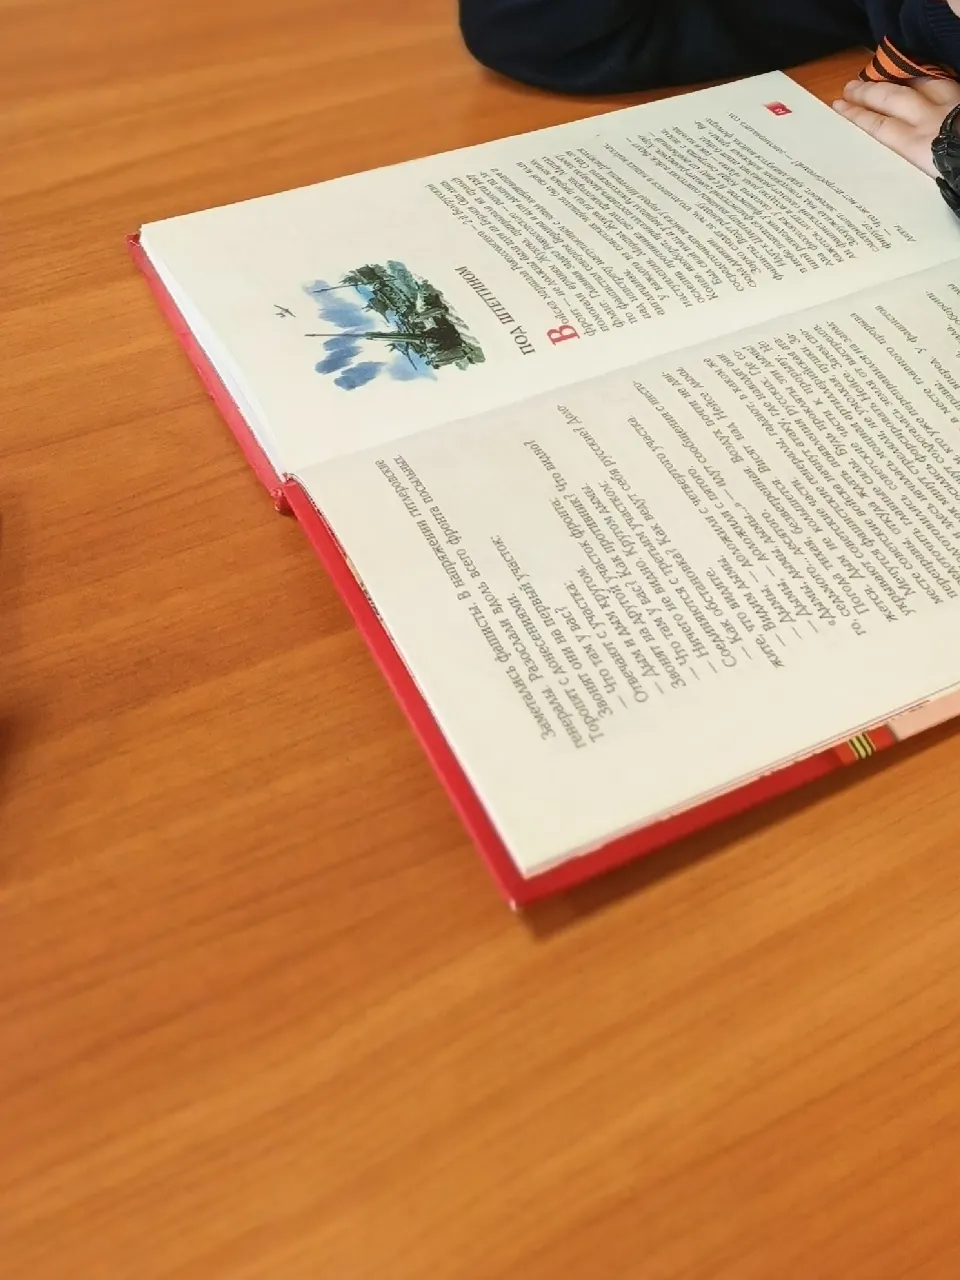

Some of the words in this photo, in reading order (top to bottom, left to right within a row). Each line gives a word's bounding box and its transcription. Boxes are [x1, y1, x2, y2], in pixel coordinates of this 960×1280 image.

[453, 265, 517, 326] ШТЕТТИНОМ
[508, 324, 537, 356] ПОД
[522, 439, 558, 473] видно?
[571, 423, 618, 471] русские?
[551, 470, 569, 494] Что
[605, 465, 635, 496] себя
[654, 451, 708, 509] четвертого
[421, 503, 463, 549] фронта
[559, 491, 621, 558] противник?
[623, 489, 658, 525] ведут
[415, 518, 469, 592] напряжении
[597, 512, 642, 561] Кругом
[631, 527, 676, 578] третьим
[643, 520, 672, 548] Как
[701, 511, 755, 571] доложили
[716, 507, 772, 564] доложили
[452, 547, 482, 580] всего
[576, 537, 619, 587] участок
[607, 553, 635, 582] Как
[663, 547, 725, 618] обстановка?
[475, 580, 507, 617] вдоль
[516, 579, 561, 632] первый
[602, 580, 649, 628] другой
[620, 576, 654, 610] вас?
[738, 588, 781, 633] Видим
[551, 604, 583, 637] вас?
[602, 607, 633, 637] дым
[649, 613, 678, 644] там
[665, 611, 712, 660] Ничего
[670, 584, 738, 669] Соединяются
[714, 617, 745, 646] Как
[735, 608, 759, 636] что
[495, 616, 545, 684] Разослали
[559, 645, 584, 673] они
[579, 643, 604, 669] там
[600, 640, 650, 704] Отвечают
[627, 646, 661, 678] Дым
[647, 641, 688, 690] Звонят
[663, 637, 693, 668] Что
[504, 663, 557, 741] Заметались
[571, 671, 615, 720] Звонят
[595, 667, 620, 696] Что
[562, 687, 606, 743] Торопят
